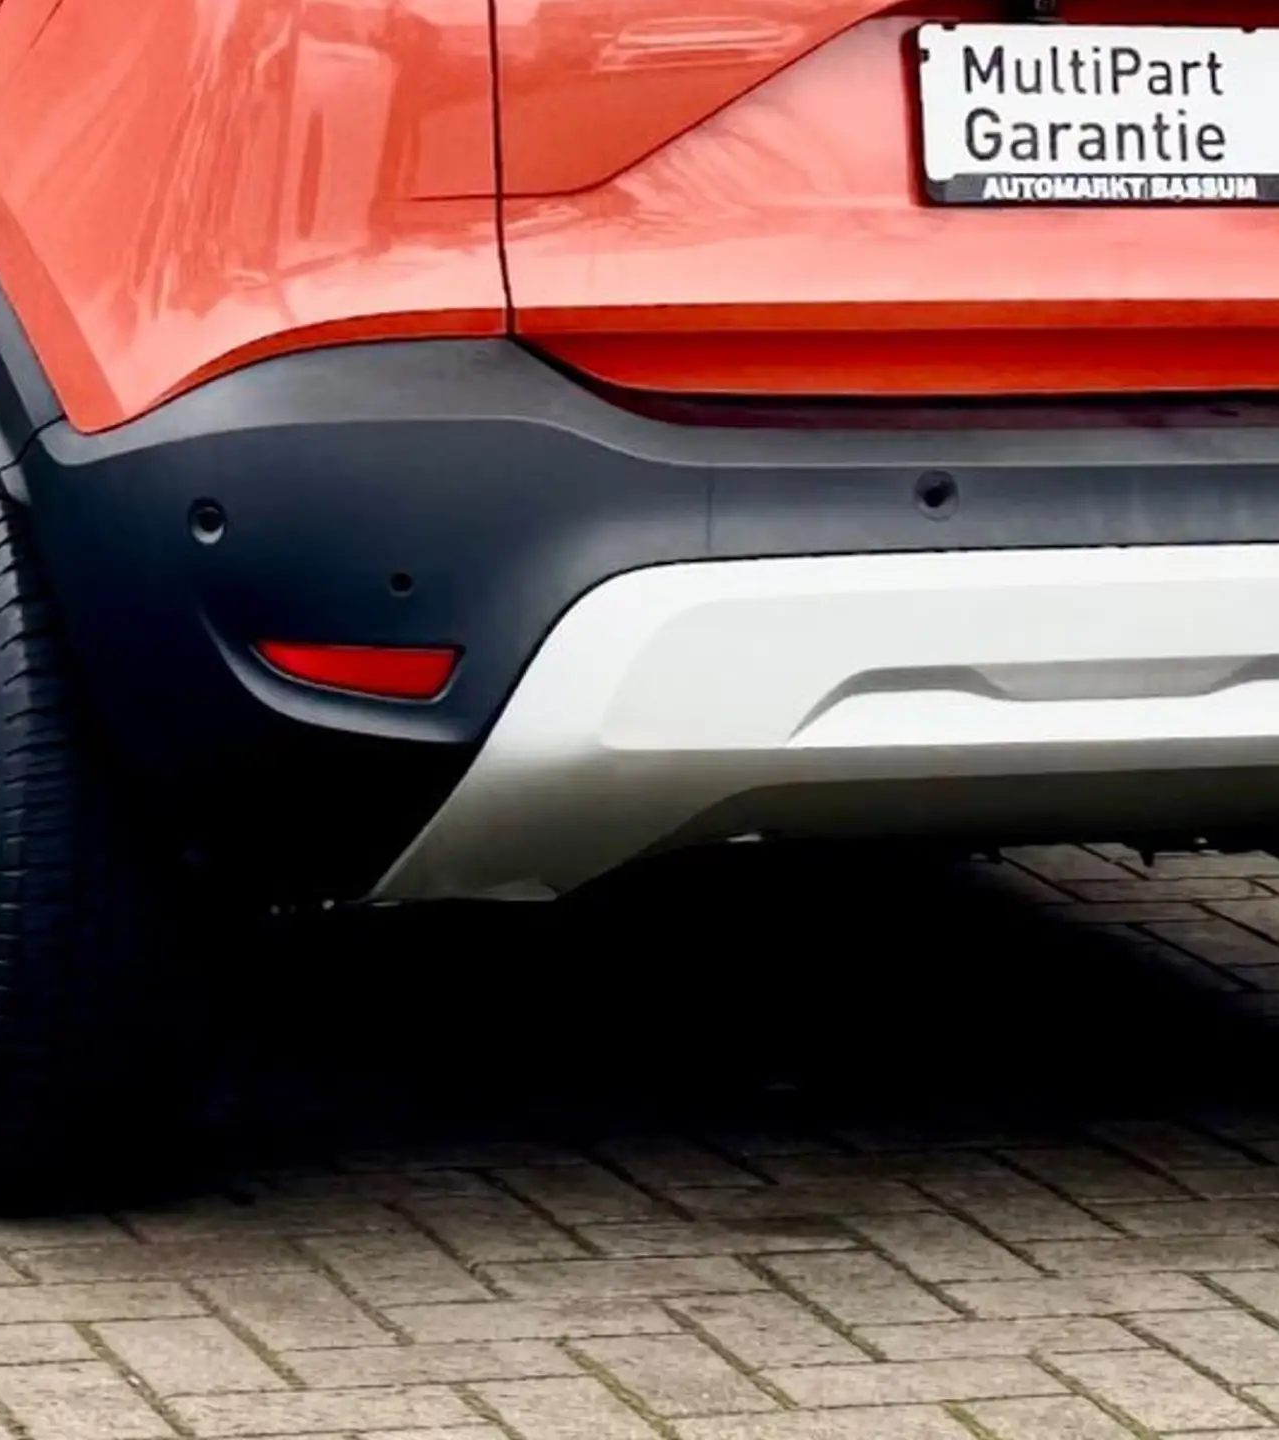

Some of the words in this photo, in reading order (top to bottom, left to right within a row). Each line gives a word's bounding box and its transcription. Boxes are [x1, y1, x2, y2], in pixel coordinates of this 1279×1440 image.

[963, 45, 1225, 96] MultiPart
[964, 106, 1226, 162] Garantie
[982, 175, 1145, 200] AUTOMARKT
[1151, 176, 1257, 201] BASSUM
